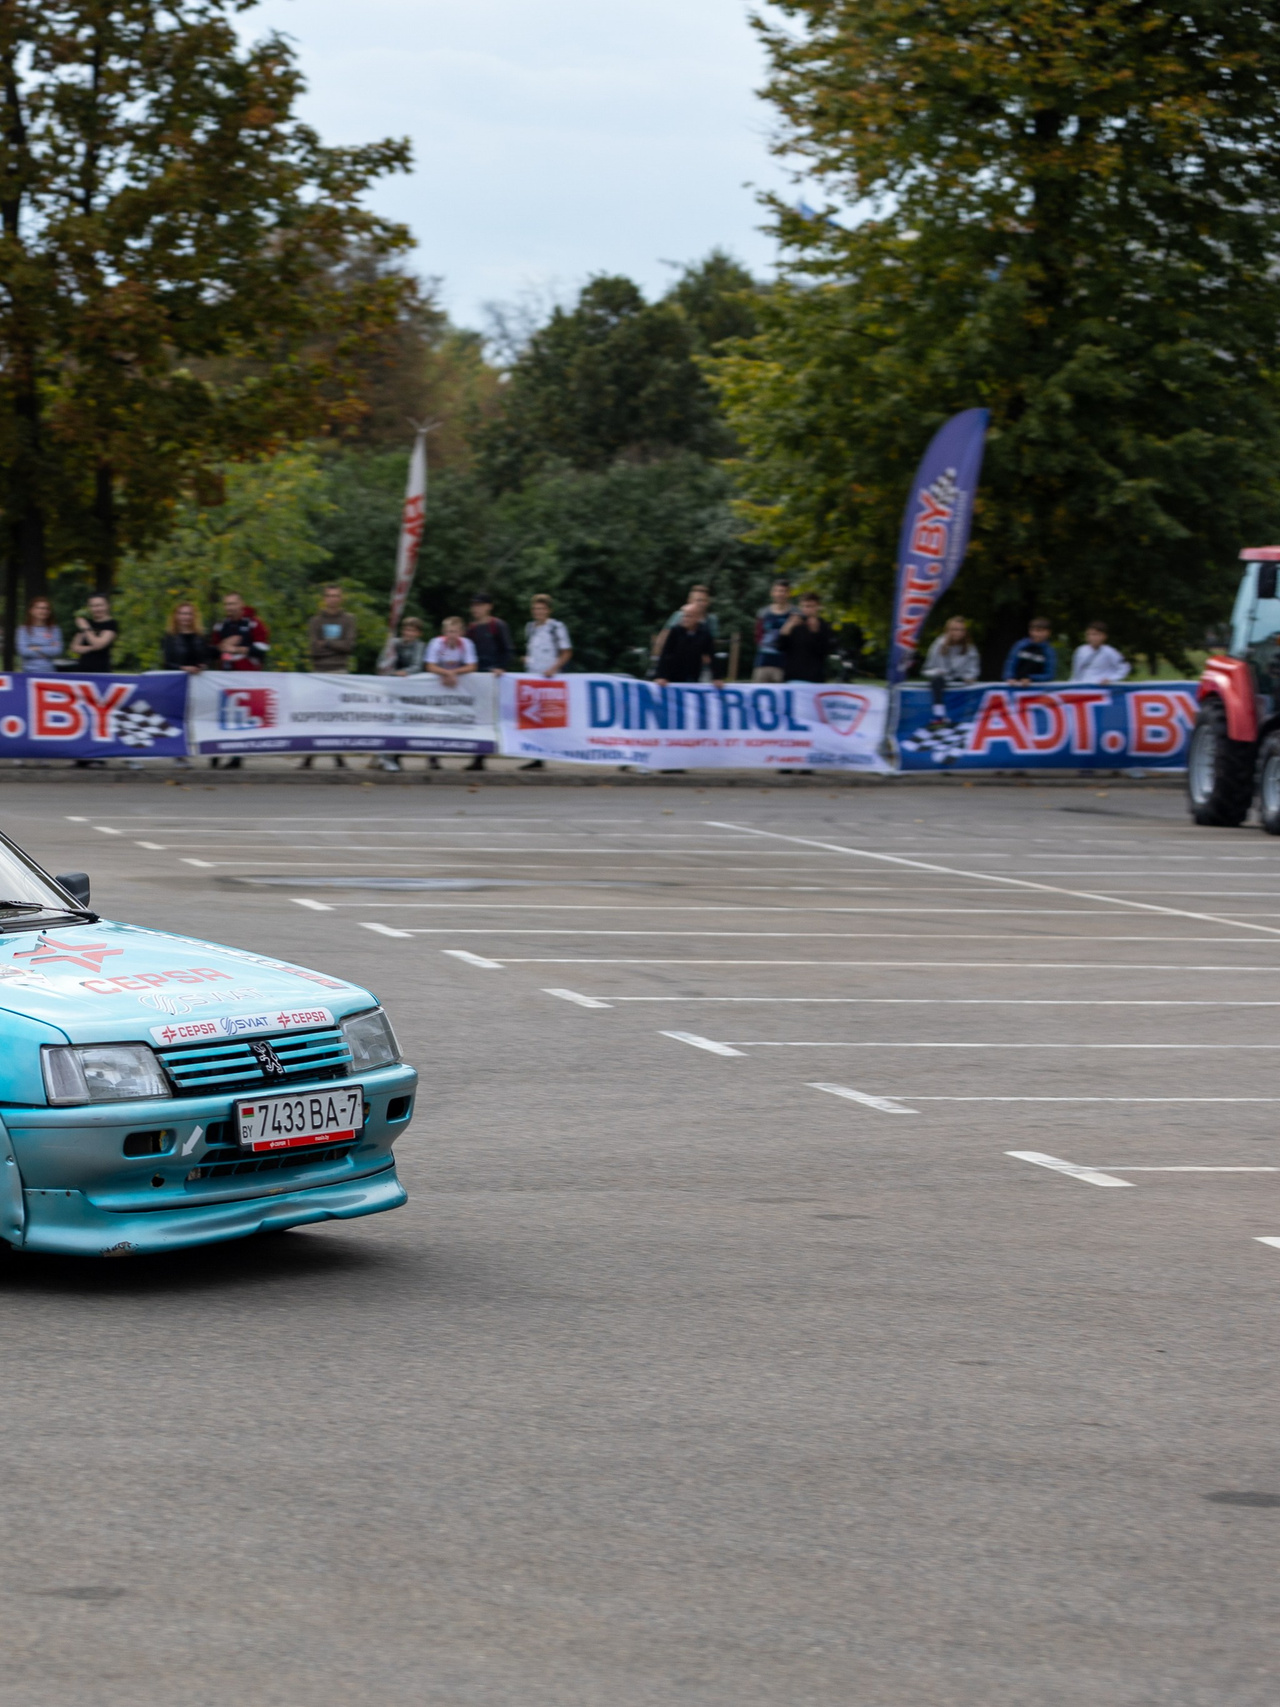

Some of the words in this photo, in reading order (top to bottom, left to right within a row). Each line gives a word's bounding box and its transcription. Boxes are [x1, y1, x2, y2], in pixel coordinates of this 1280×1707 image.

[587, 680, 811, 732] DINITROL
[81, 967, 234, 995] CEPSA
[235, 1016, 268, 1030] SVIAT
[292, 1011, 327, 1024] CEPSA
[178, 1023, 217, 1038] CEPSA
[258, 1100, 306, 1137] 7433
[309, 1094, 357, 1129] BA-7
[242, 1125, 253, 1138] BY
